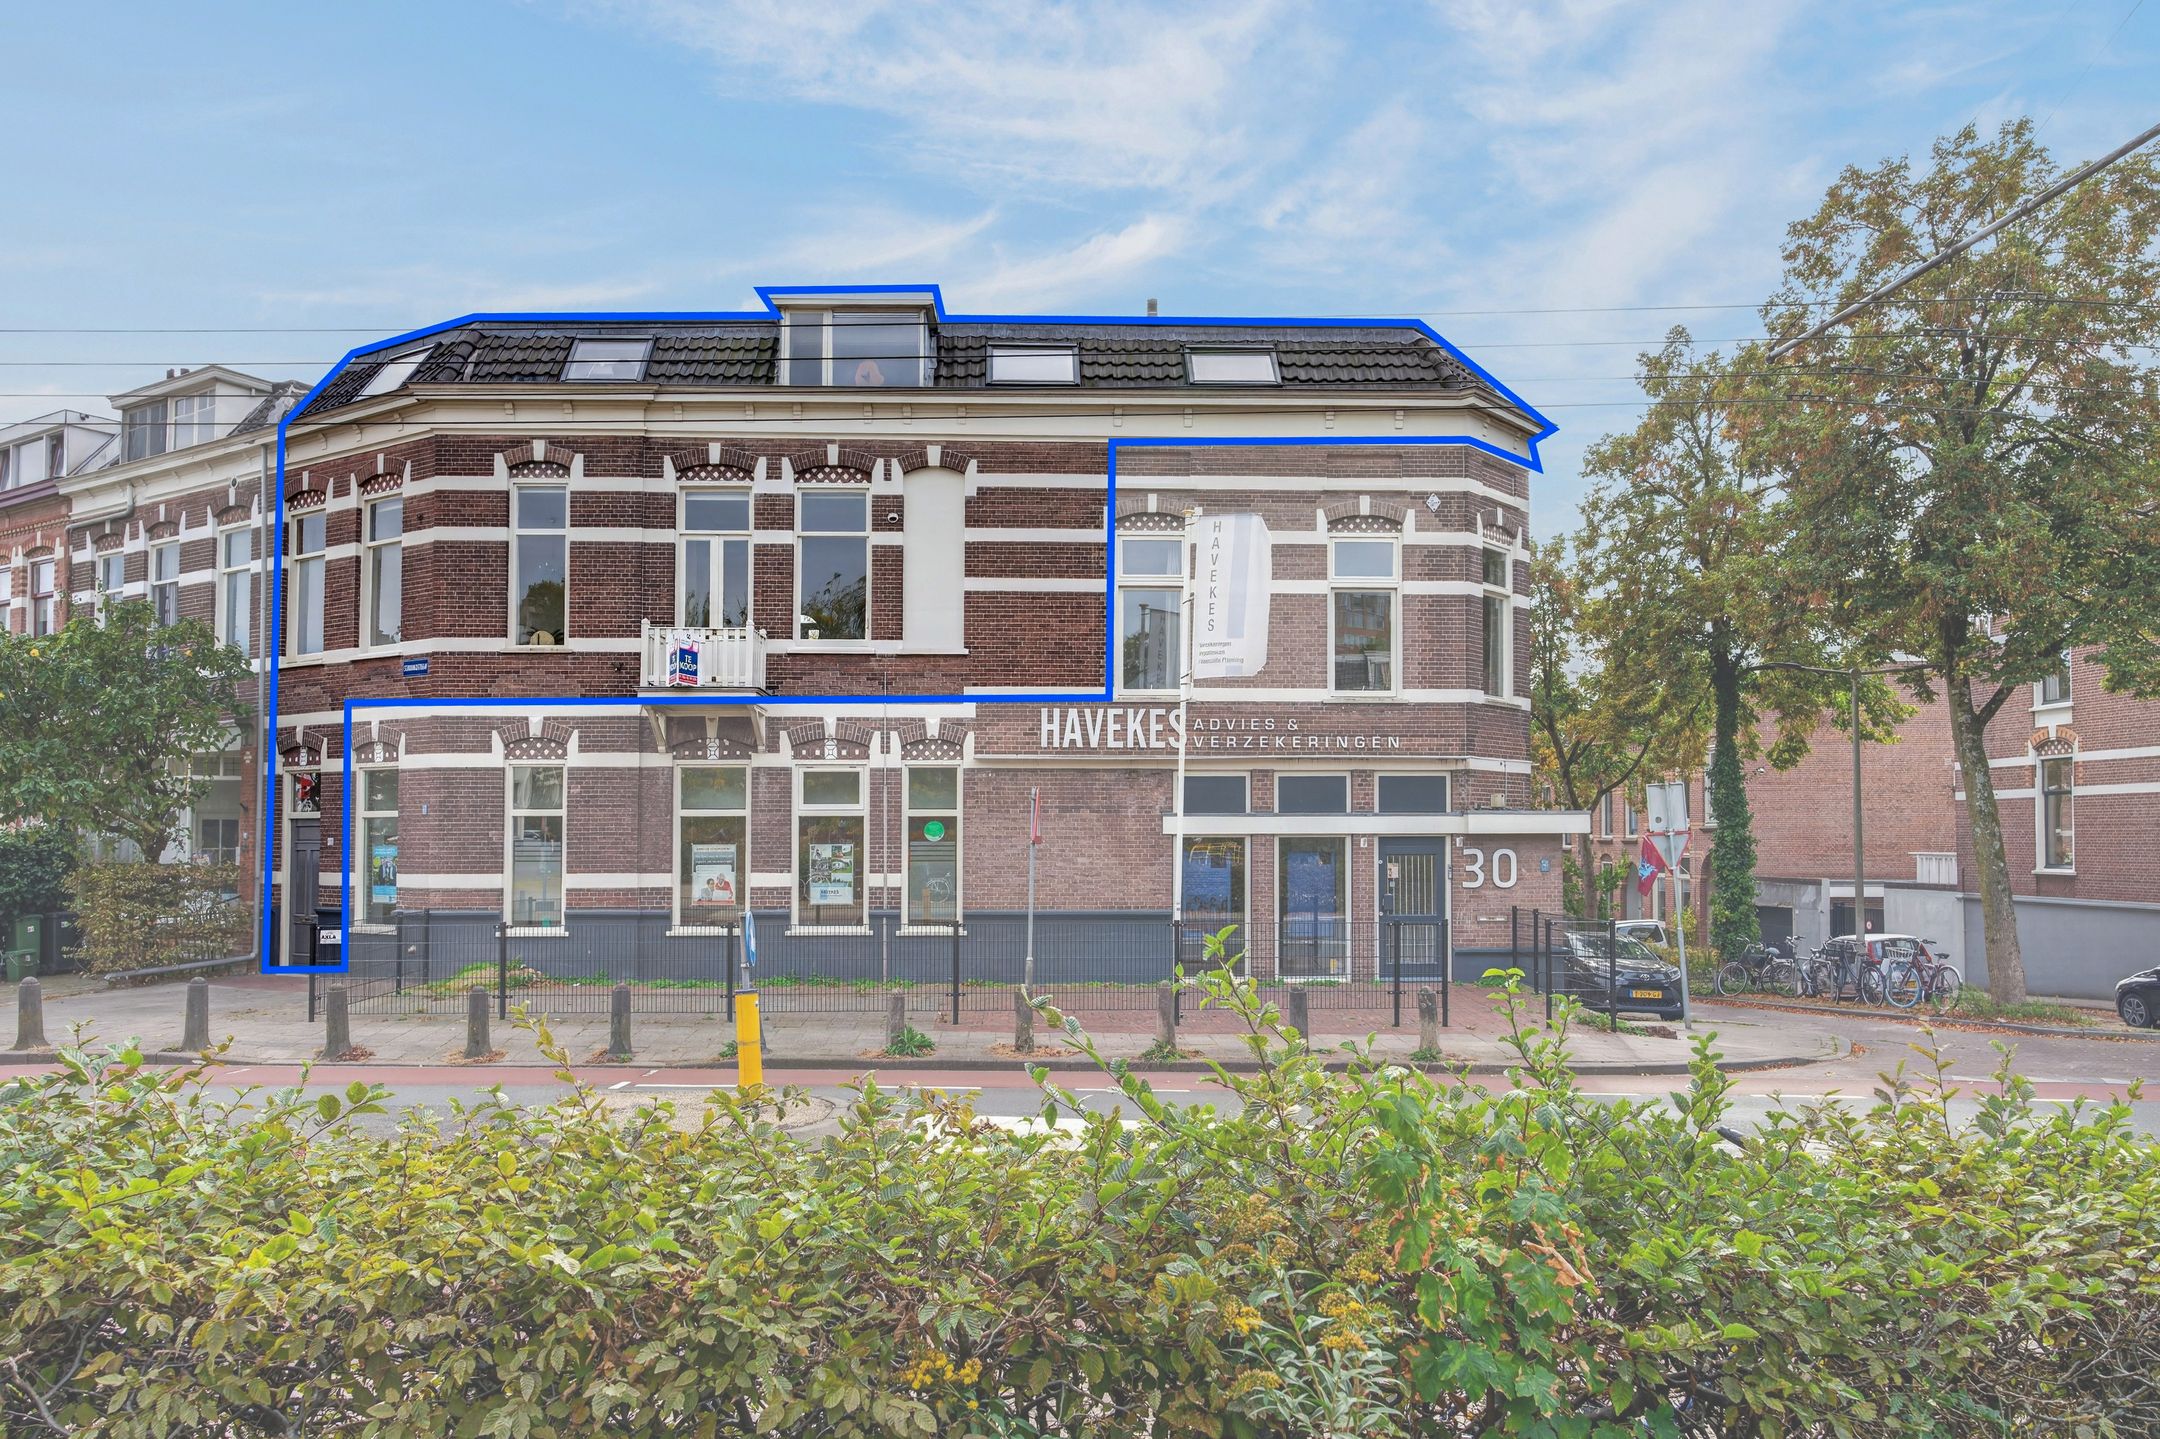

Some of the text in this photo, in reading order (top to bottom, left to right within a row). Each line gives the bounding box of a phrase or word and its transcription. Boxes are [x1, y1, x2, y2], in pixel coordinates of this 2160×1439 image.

[1207, 520, 1222, 632] HAVEKES
[684, 654, 692, 663] TE
[680, 661, 697, 671] KOOP
[1040, 708, 1188, 749] HAVEKES
[1193, 718, 1299, 731] ADVIES &
[1193, 736, 1400, 748] VERZEKERINGEN
[1462, 848, 1518, 889] 30
